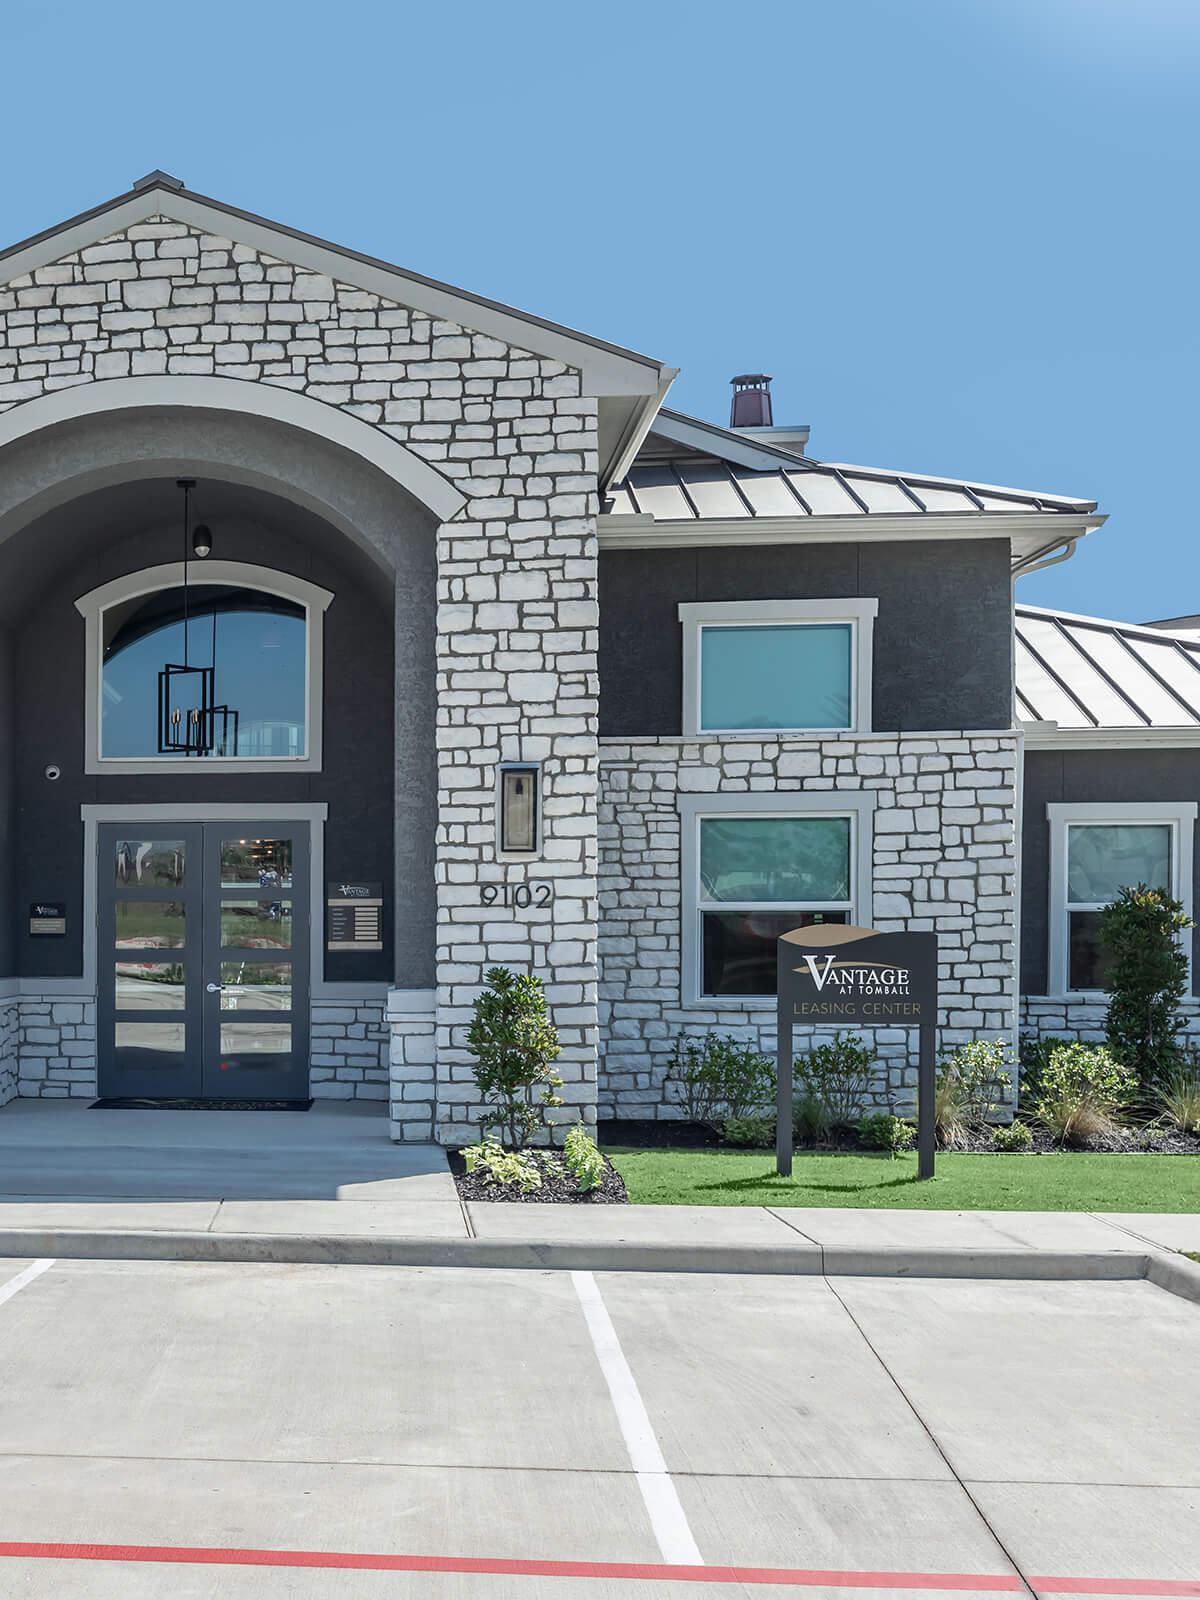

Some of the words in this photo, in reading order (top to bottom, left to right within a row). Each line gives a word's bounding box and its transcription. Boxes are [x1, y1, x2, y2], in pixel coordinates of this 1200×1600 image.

[480, 885, 551, 909] 9102
[801, 954, 910, 992] VANTAGE
[839, 985, 852, 995] AT
[859, 985, 910, 995] TOMBALL
[793, 1002, 856, 1015] LEASING
[862, 1002, 921, 1015] CENTER
